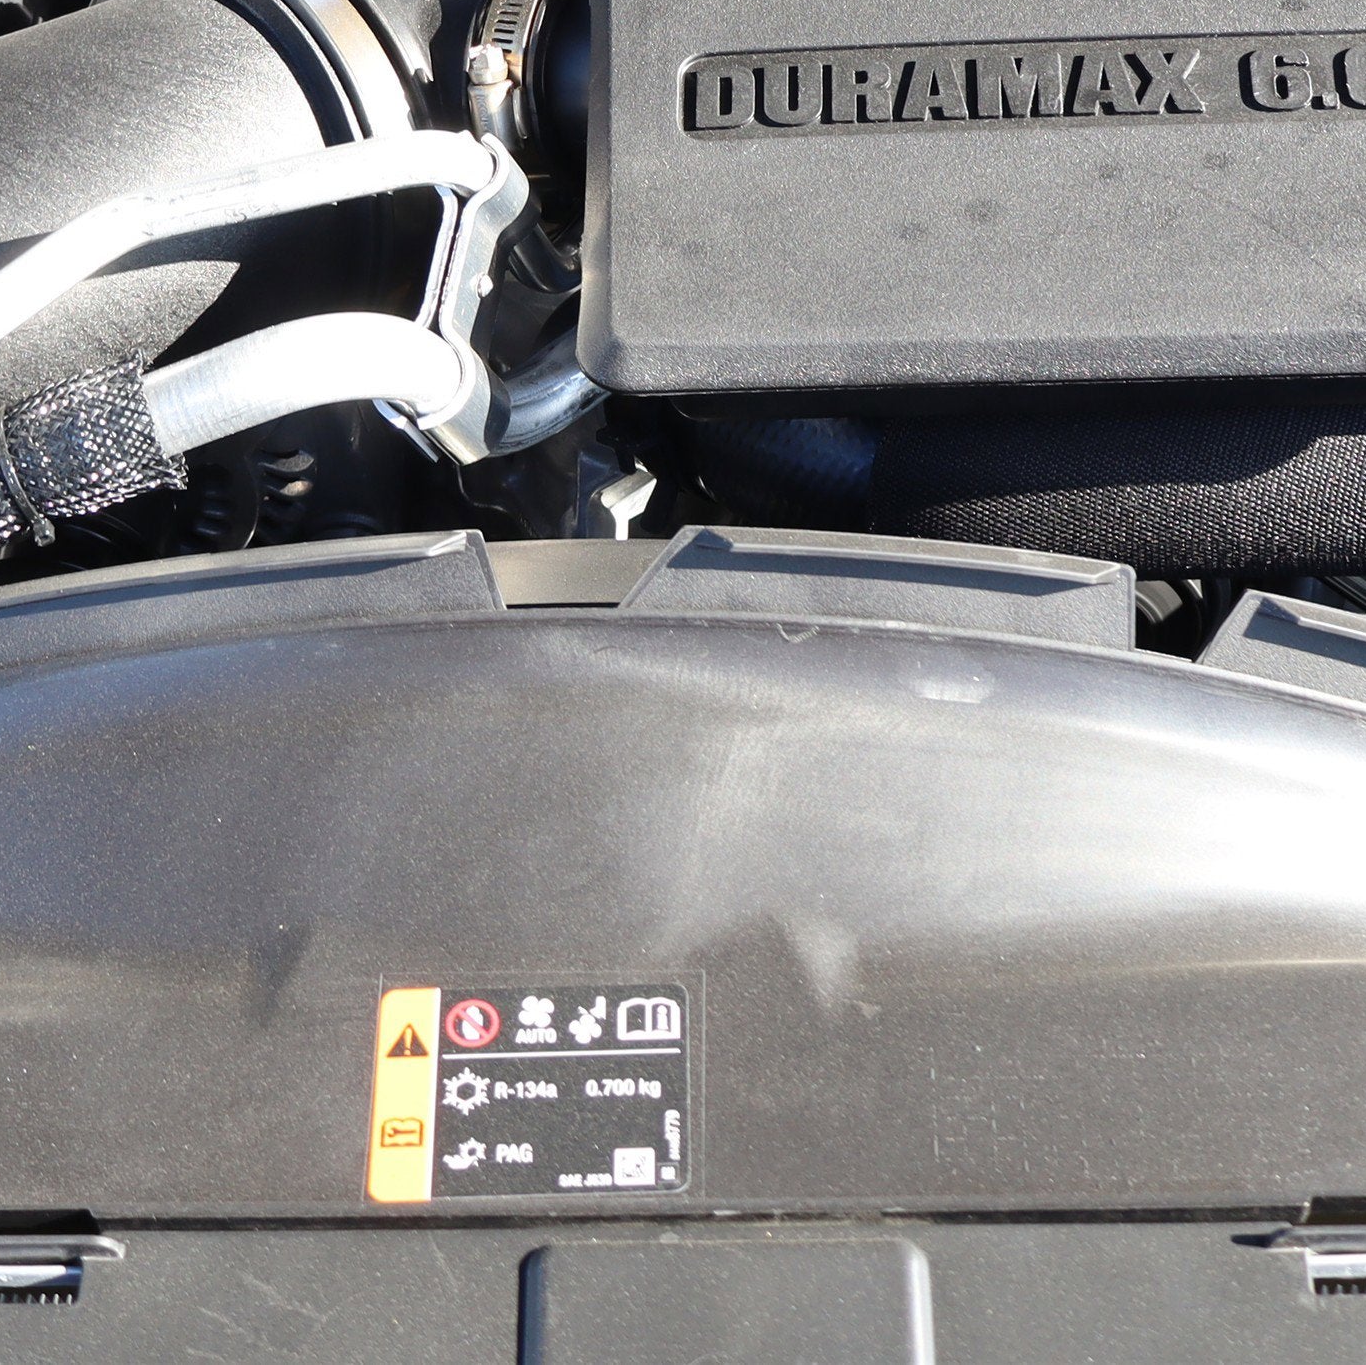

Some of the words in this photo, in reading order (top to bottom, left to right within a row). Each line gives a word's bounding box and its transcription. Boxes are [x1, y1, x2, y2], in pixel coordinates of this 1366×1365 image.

[695, 50, 1204, 129] DURAMAX
[515, 1029, 557, 1045] AUTO
[494, 1081, 558, 1099] R-134a
[585, 1079, 635, 1097] 0.700
[639, 1078, 661, 1099] kg
[495, 1143, 533, 1163] PAG
